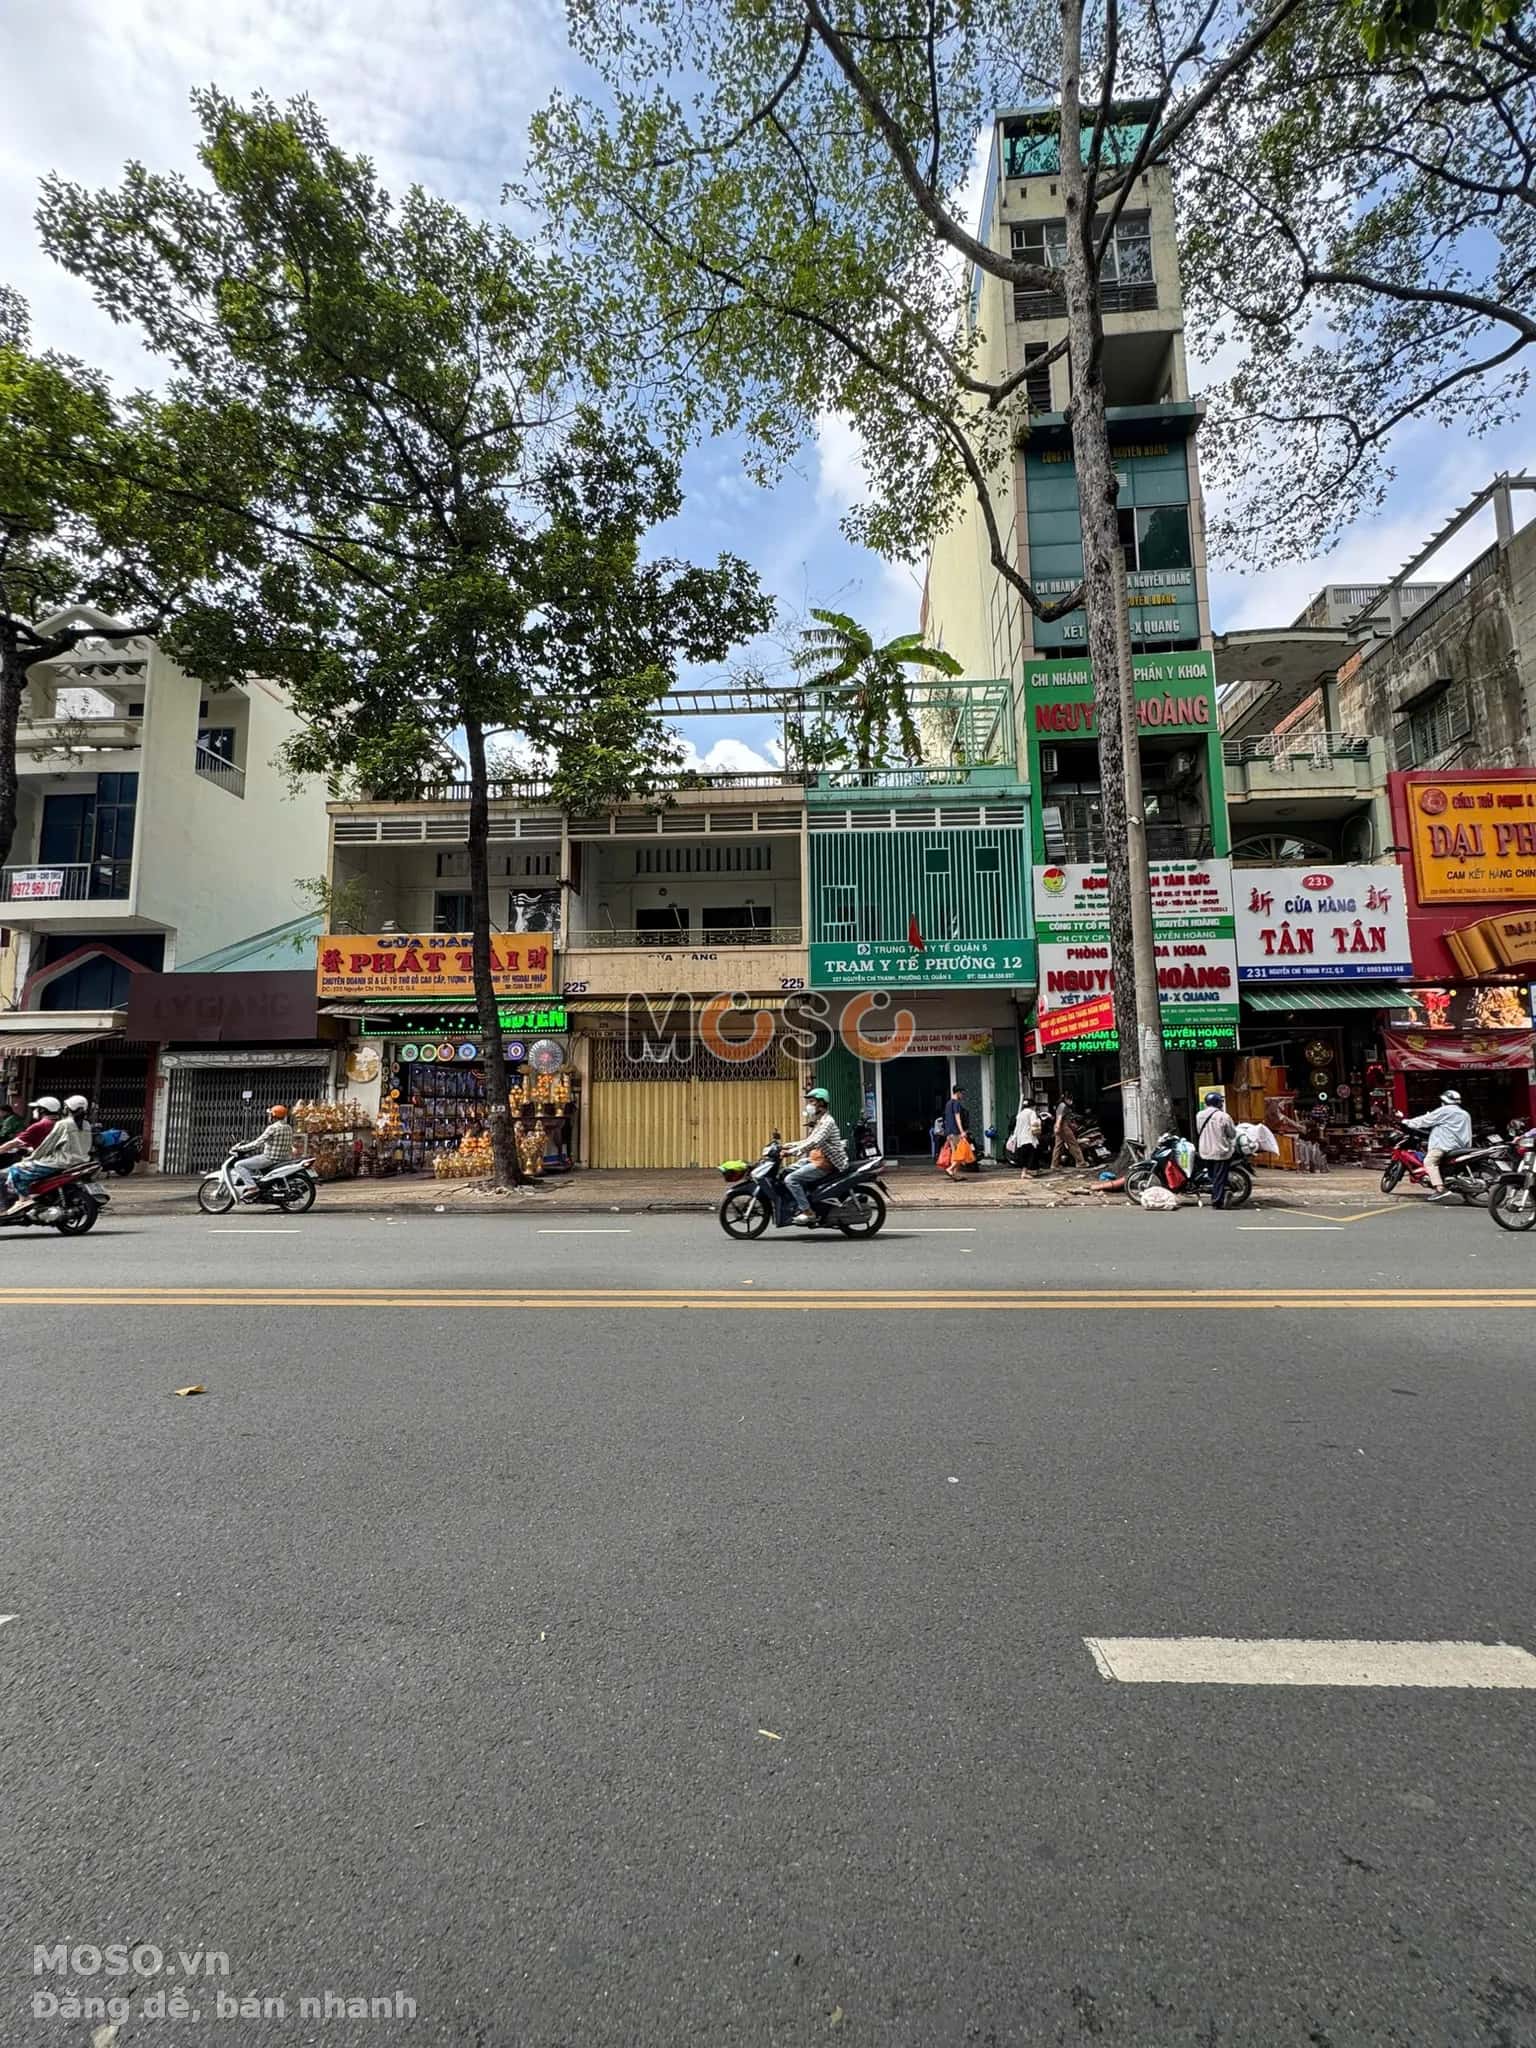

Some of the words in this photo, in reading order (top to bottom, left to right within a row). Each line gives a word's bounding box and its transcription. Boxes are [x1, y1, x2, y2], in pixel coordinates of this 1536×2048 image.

[1144, 619, 1180, 634] QUANG
[1031, 673, 1049, 687] CHI
[1052, 669, 1088, 686] NHÁNH
[1166, 666, 1174, 680] Y
[1178, 663, 1208, 680] KHOA
[1035, 702, 1097, 732] NGUY
[1427, 823, 1486, 864] ĐẠI
[1492, 823, 1536, 857] PH
[1447, 871, 1466, 880] CAM
[1469, 867, 1485, 879] KẾT
[1489, 868, 1512, 878] HÀNG
[1515, 868, 1536, 878] CHÍN
[1307, 876, 1328, 887] 231
[1248, 887, 1275, 917] 新
[1285, 895, 1312, 913] CỬA
[1318, 895, 1357, 913] HÀNG
[1365, 884, 1392, 914] 新
[1073, 920, 1084, 930] TY
[1056, 934, 1070, 943] CN
[1071, 934, 1089, 943] CTY
[1259, 920, 1314, 956] TÂN
[874, 946, 905, 954] TRUNG
[931, 944, 937, 953] Y
[939, 942, 951, 953] TẾ
[953, 942, 979, 953] QUẬN
[981, 943, 988, 951] 5
[1067, 945, 1108, 960] PHÒNG
[1173, 944, 1207, 957] KHOA
[350, 944, 446, 974] PHÁT
[824, 959, 874, 975] TRẠM
[879, 960, 891, 972] Y
[896, 954, 919, 972] TẾ
[925, 957, 996, 971] PHƯỜNG
[1003, 957, 1023, 969] 12
[1046, 969, 1113, 992] NGUY
[1247, 968, 1267, 978] 231
[564, 982, 587, 993] 225
[781, 978, 805, 989] 225
[1182, 992, 1220, 1003] QUANG
